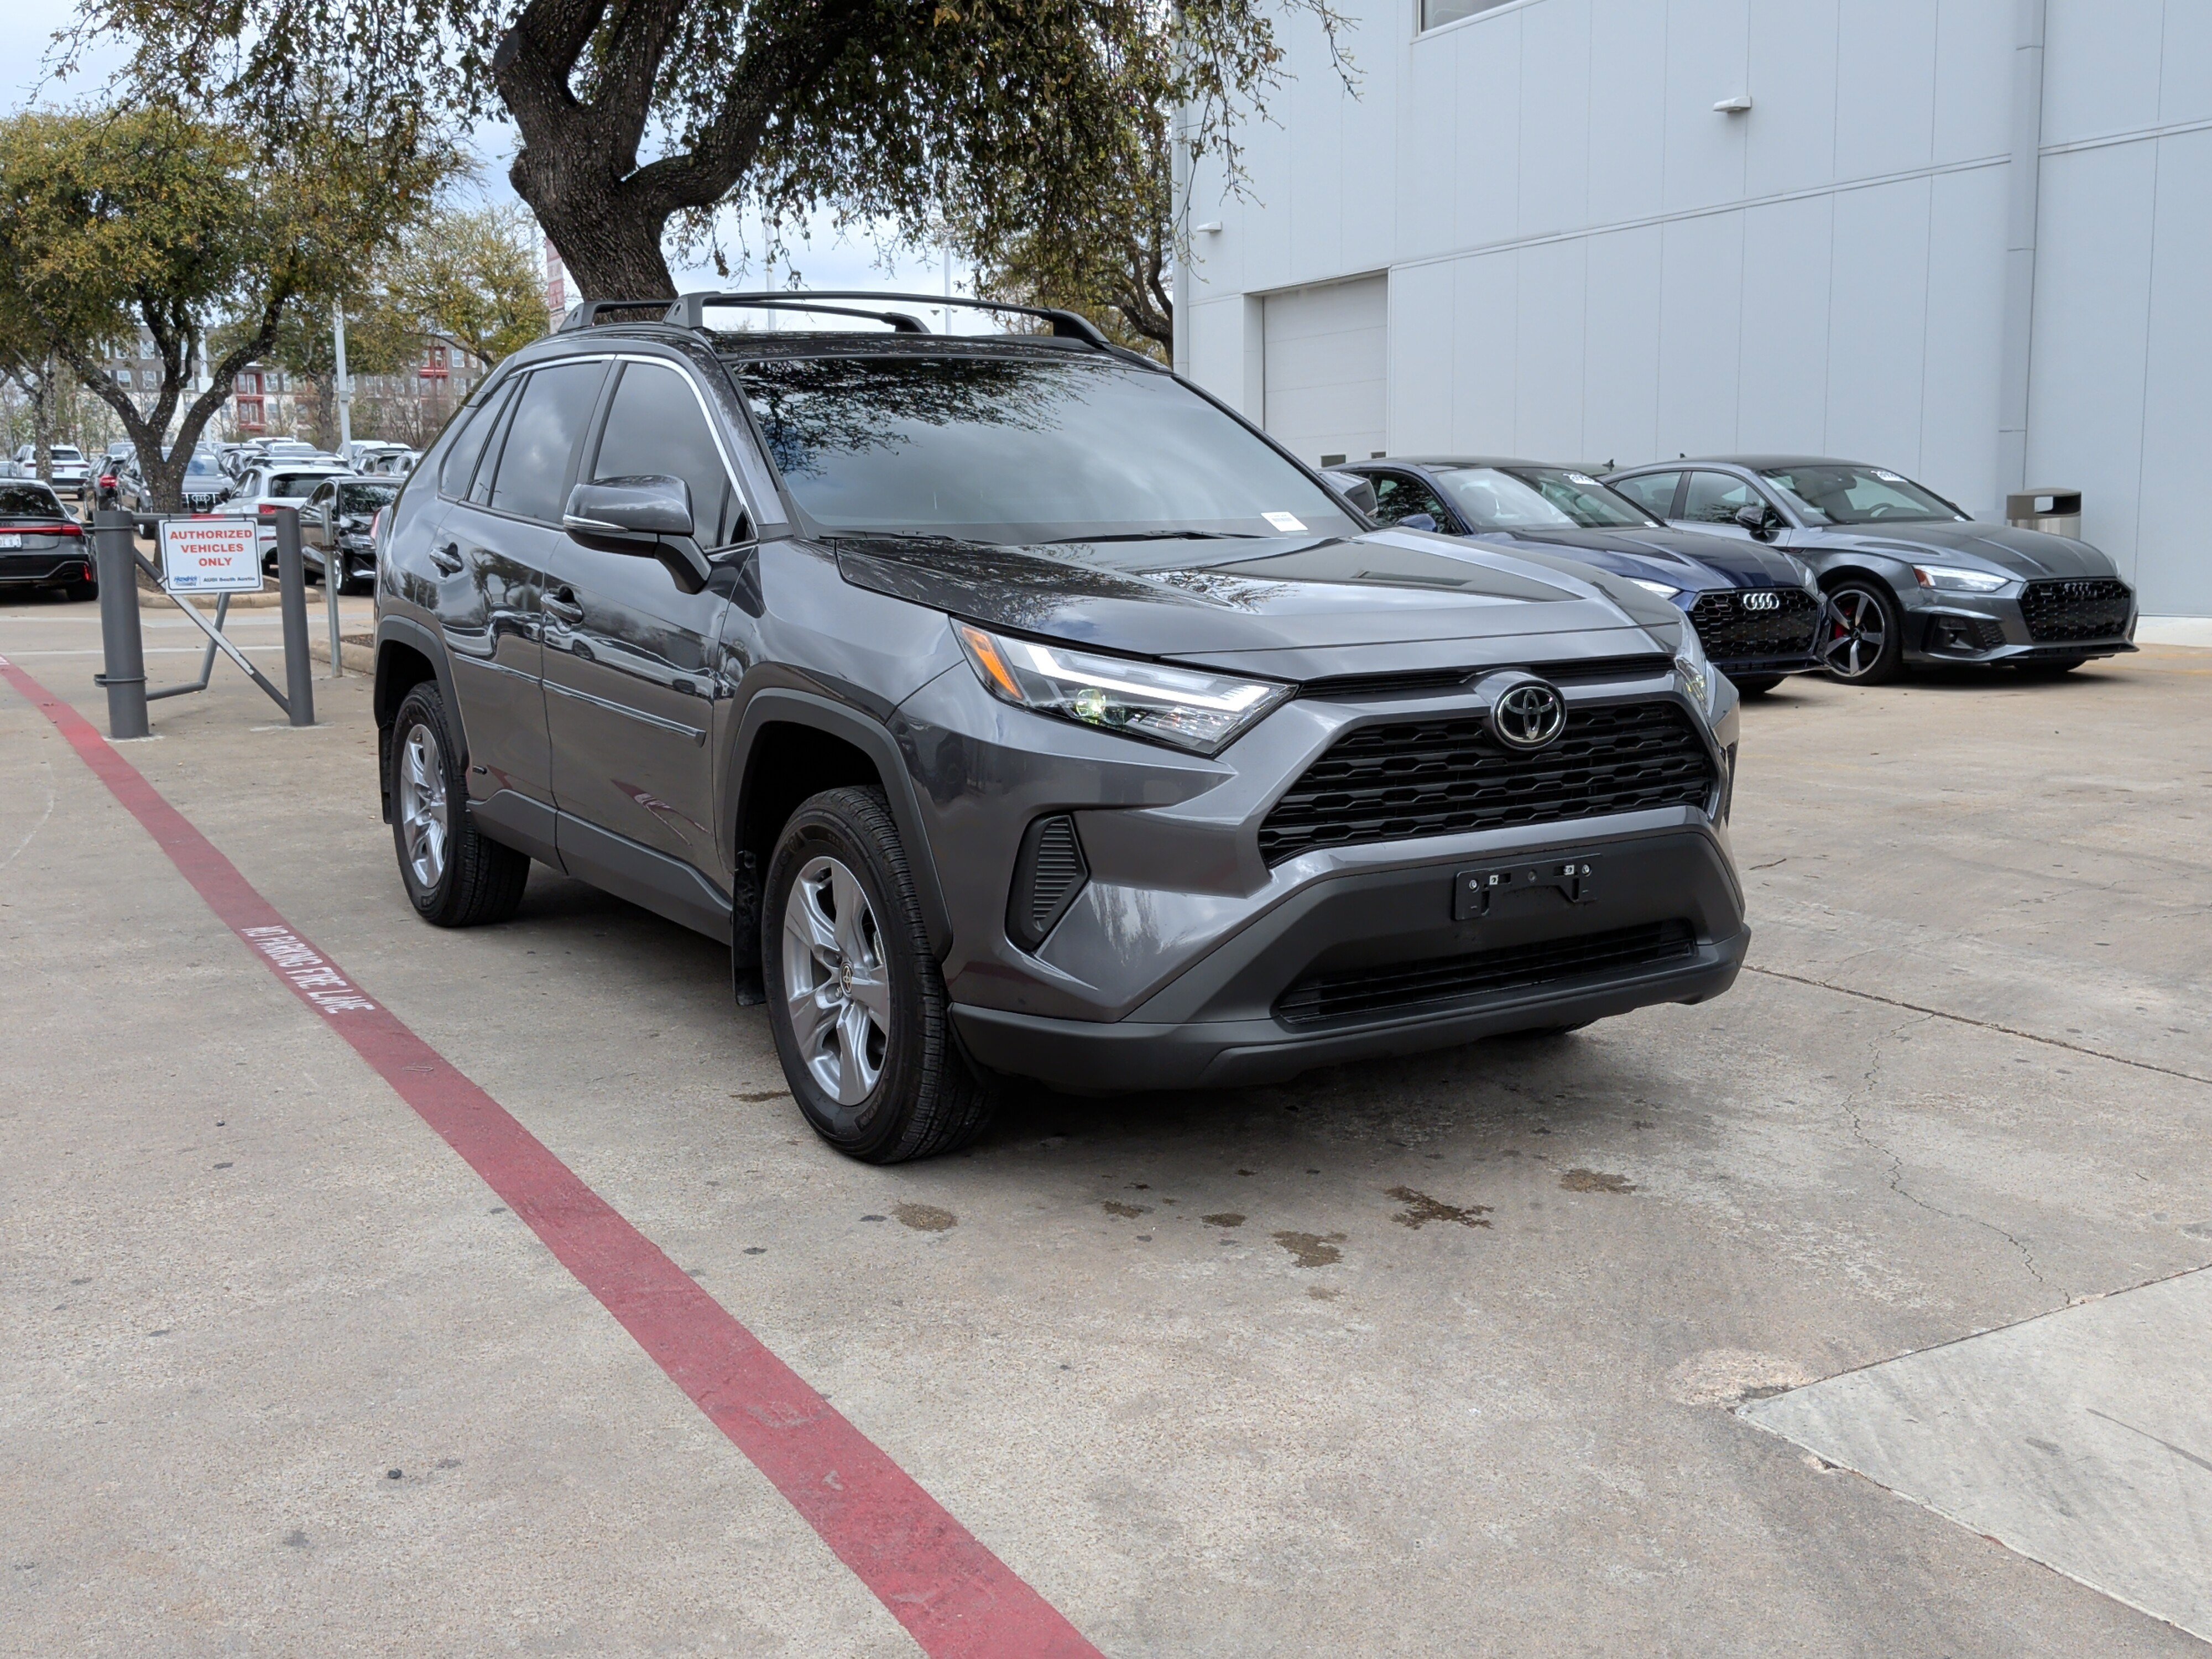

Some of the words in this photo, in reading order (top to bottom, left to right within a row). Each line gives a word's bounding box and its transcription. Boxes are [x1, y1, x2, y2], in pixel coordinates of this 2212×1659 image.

[170, 530, 252, 539] AUTHORIZED
[181, 544, 244, 553] VEHICLES
[199, 557, 232, 566] ONLY
[241, 925, 289, 937] NO
[253, 935, 324, 967] PARKING
[285, 967, 348, 989] FIRE
[307, 989, 376, 1014] LANE
